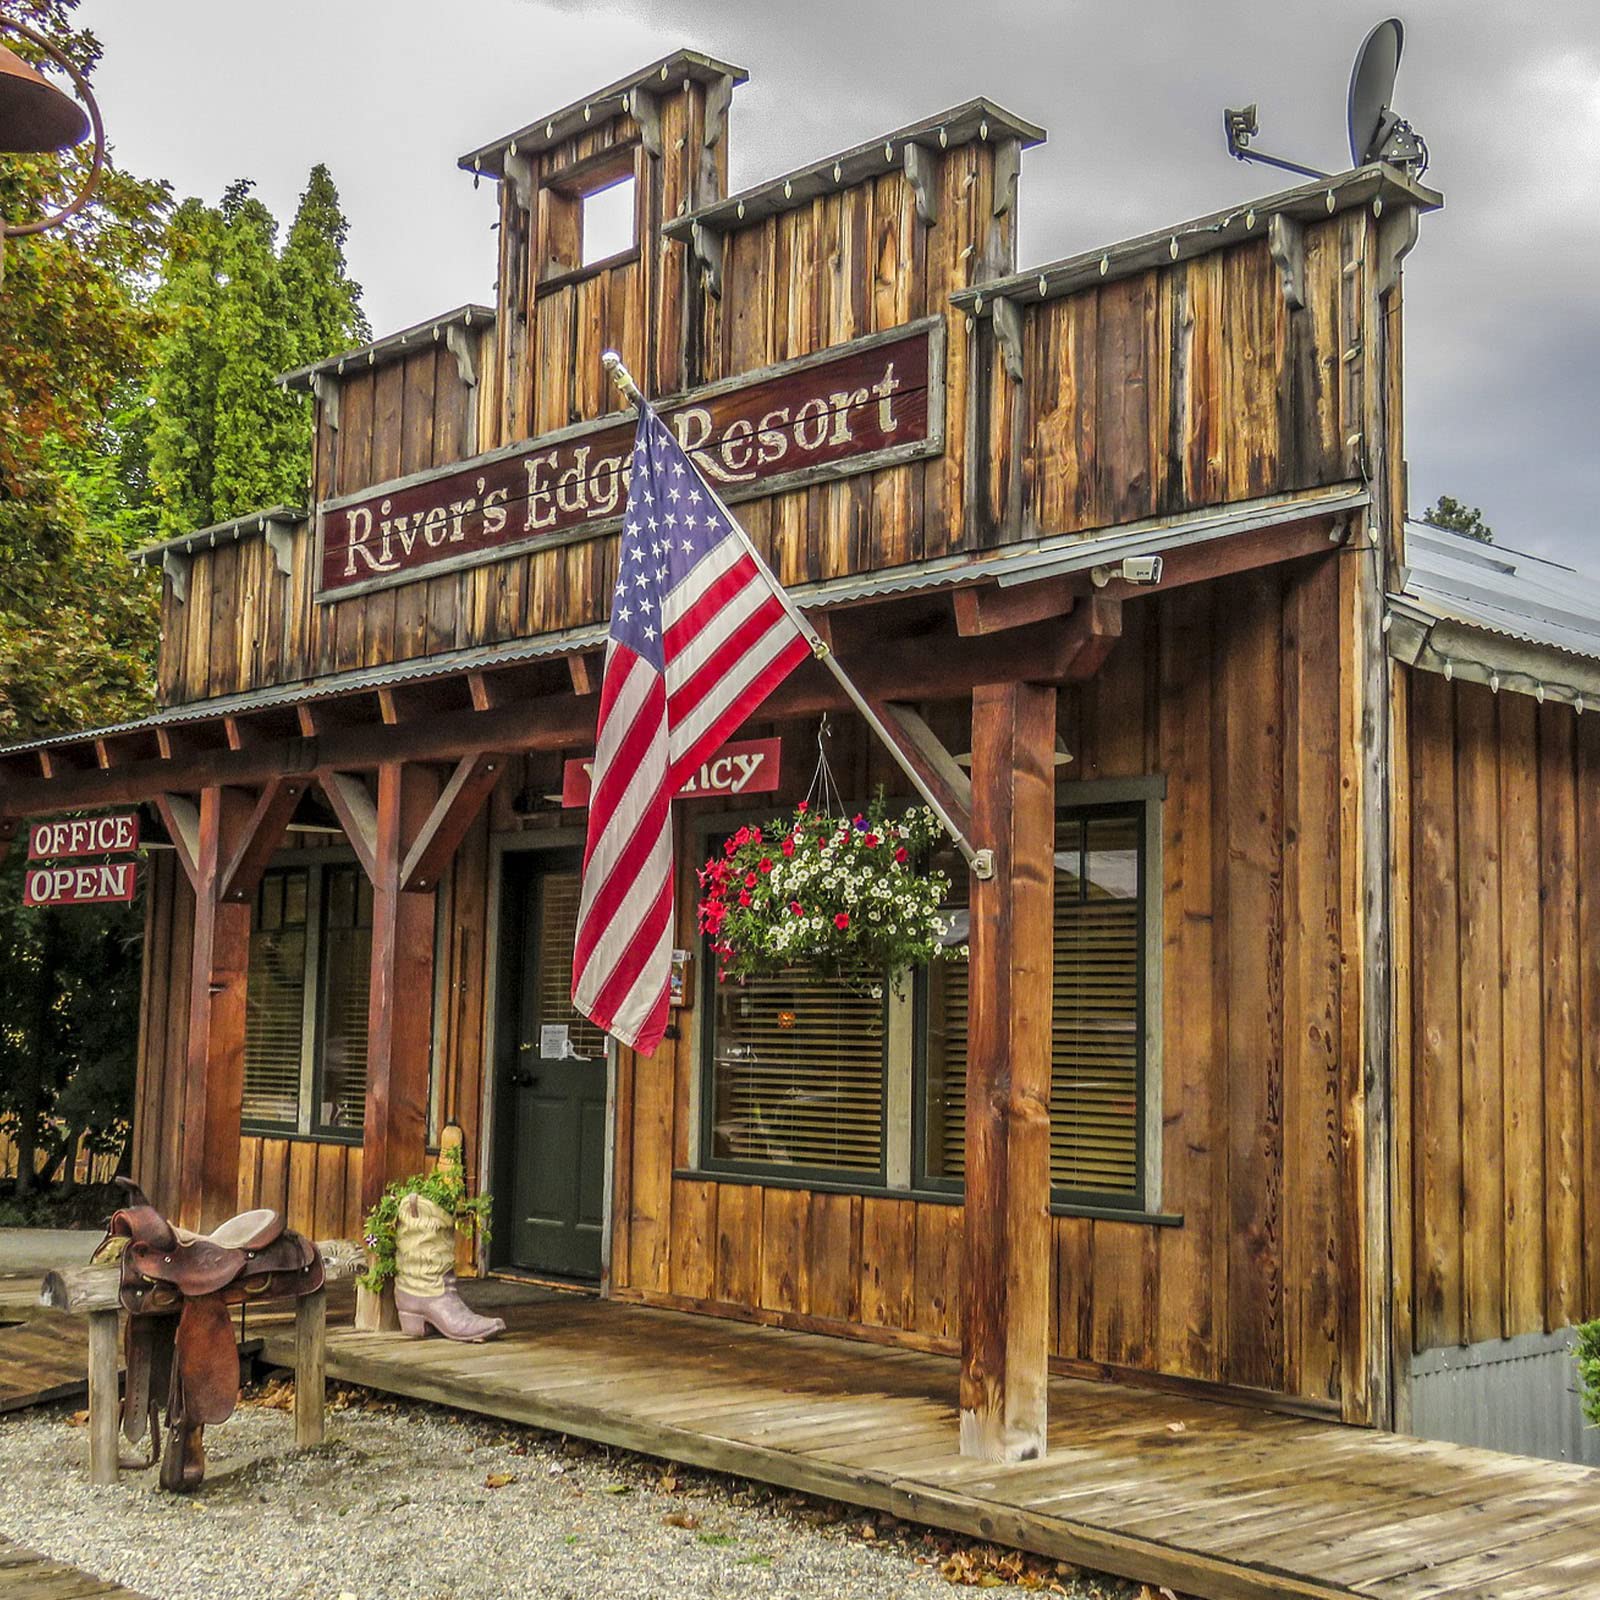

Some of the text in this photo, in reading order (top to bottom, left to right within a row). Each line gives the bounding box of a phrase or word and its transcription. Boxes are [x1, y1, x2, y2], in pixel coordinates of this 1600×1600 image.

[344, 477, 507, 576] River's
[674, 362, 899, 483] Resort
[35, 816, 133, 855] OFFICE
[30, 865, 127, 902] OPEN
